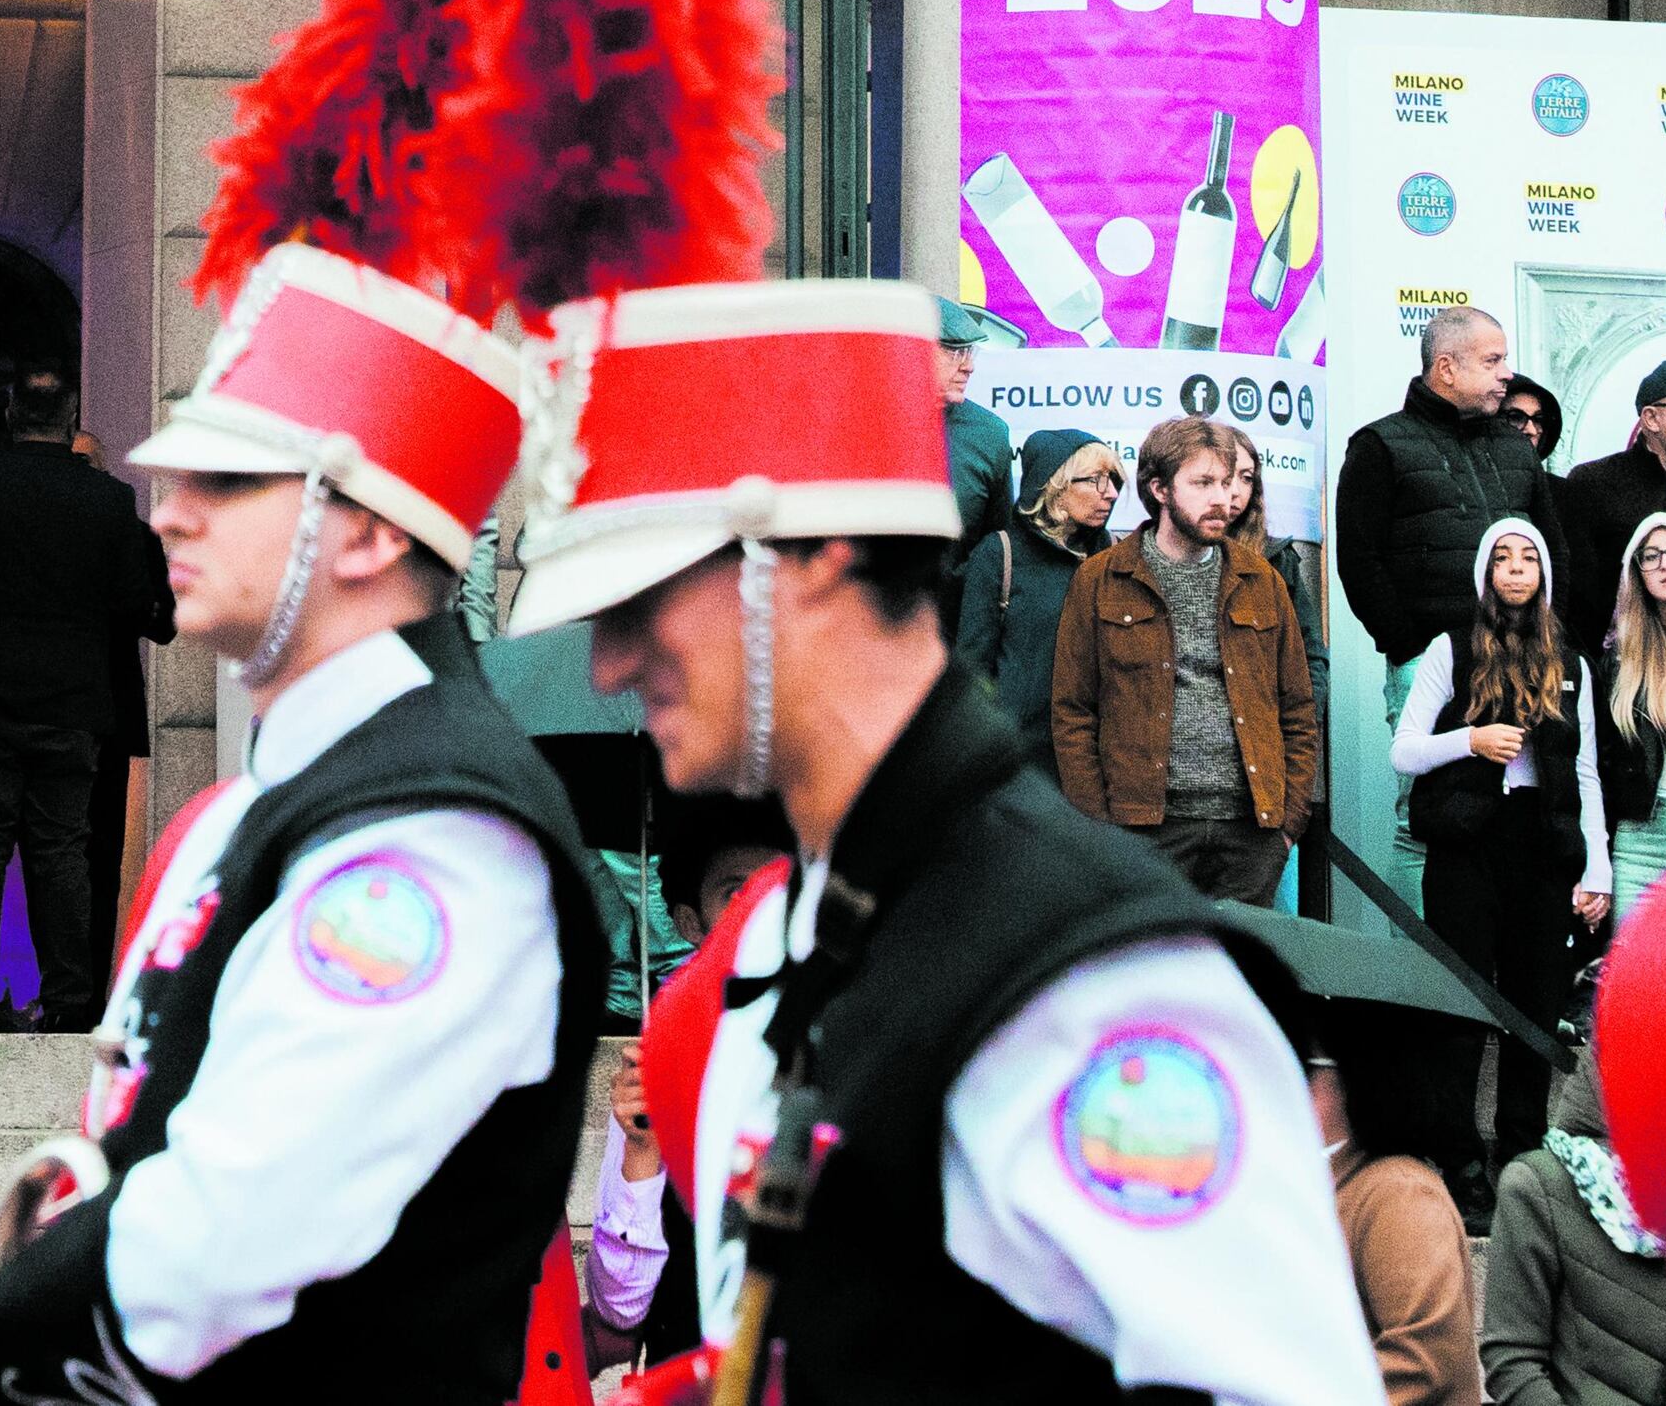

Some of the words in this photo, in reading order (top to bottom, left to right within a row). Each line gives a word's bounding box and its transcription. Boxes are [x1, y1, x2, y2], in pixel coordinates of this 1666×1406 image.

[1396, 75, 1463, 90] MILANO
[1396, 92, 1442, 106] WINE
[1539, 96, 1581, 107] TERRE
[1396, 109, 1448, 123] WEEK
[1528, 185, 1595, 199] MILANO
[1405, 196, 1447, 206] TERRE
[1528, 202, 1574, 216] WINE
[1528, 219, 1580, 233] WEEK
[1400, 290, 1468, 304] MILANO
[992, 386, 1113, 408] FOLLOW
[1124, 386, 1162, 407] US
